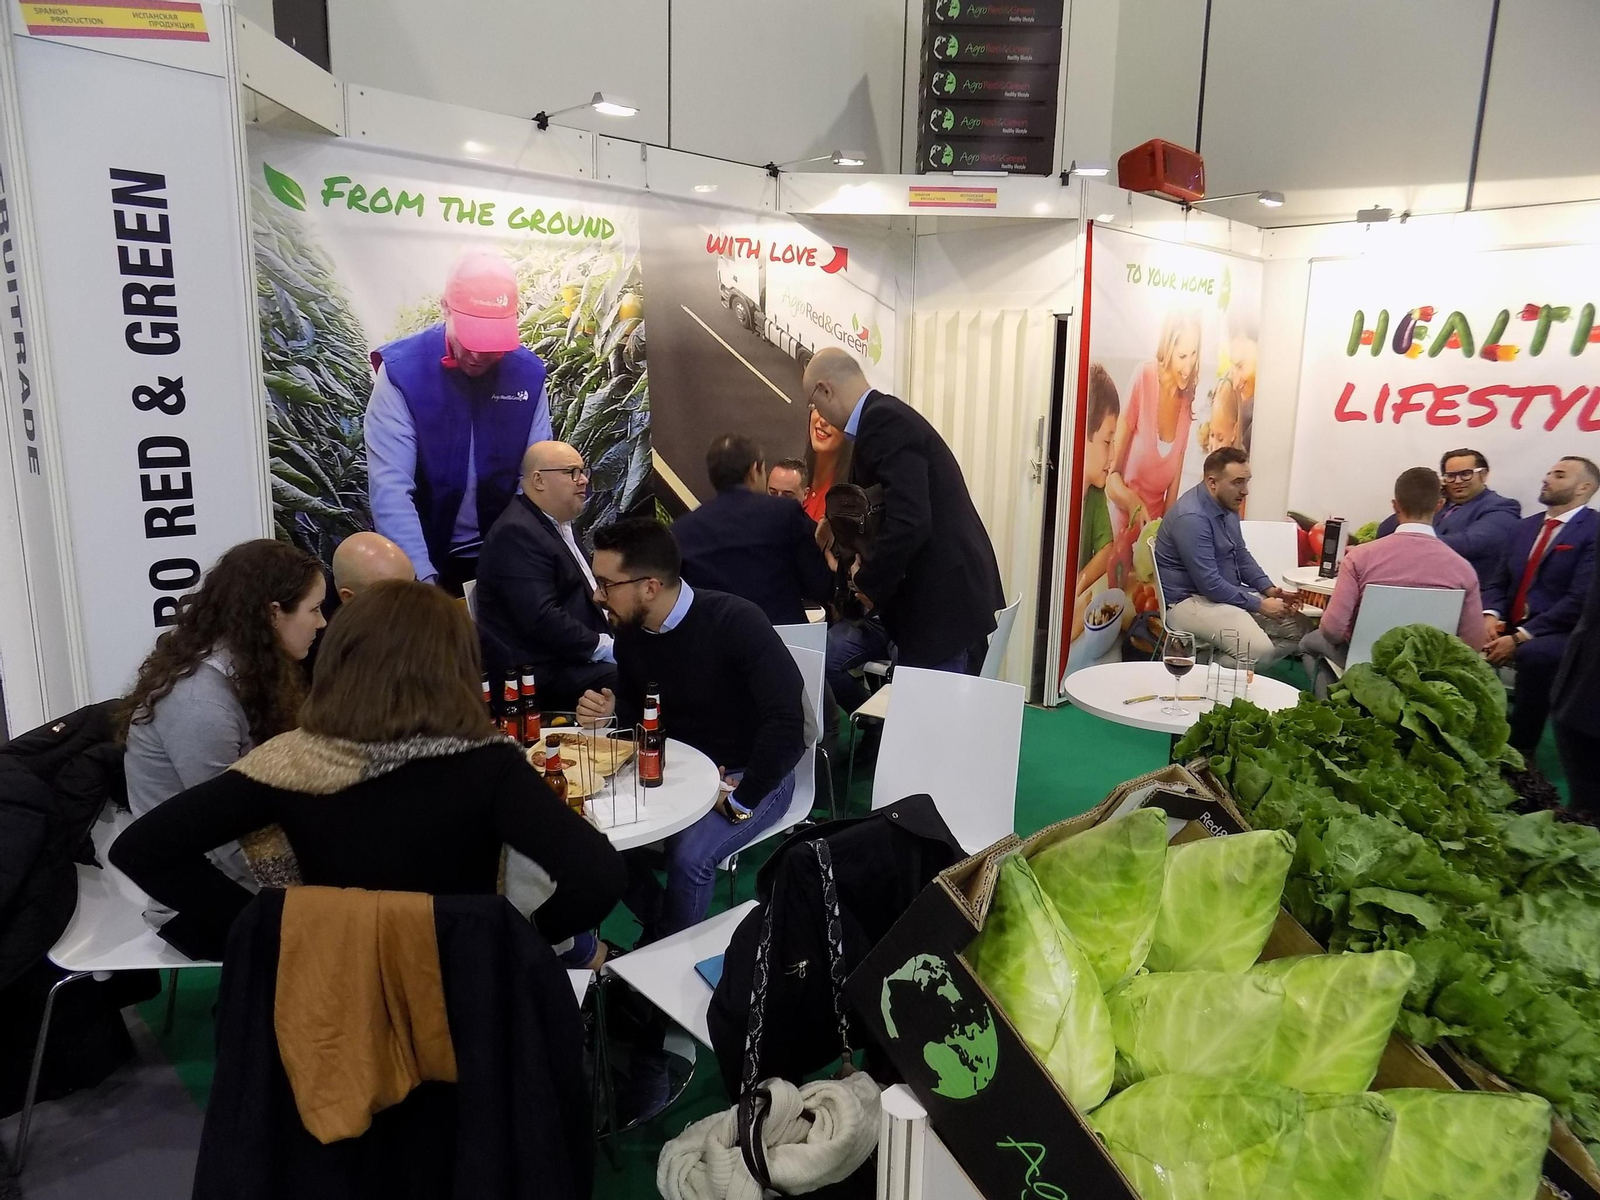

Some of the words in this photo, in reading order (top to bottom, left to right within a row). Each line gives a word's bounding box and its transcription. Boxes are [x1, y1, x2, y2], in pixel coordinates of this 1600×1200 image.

[34, 7, 68, 15] SPANISH
[51, 16, 104, 25] PRODUCTION
[132, 12, 178, 20] ИСПАНСКАЯ
[149, 20, 195, 29] ПРОДУКЦИЯ
[321, 175, 425, 218] FROM
[438, 196, 496, 227] THE
[507, 206, 615, 241] GROUND
[109, 167, 181, 356] GREEN
[706, 233, 761, 260] WITH
[769, 242, 818, 267] LOVE
[1126, 263, 1142, 284] TO
[1147, 267, 1177, 290] YOUR
[1181, 276, 1215, 296] HOME
[131, 375, 187, 416] &
[138, 435, 197, 539] RED
